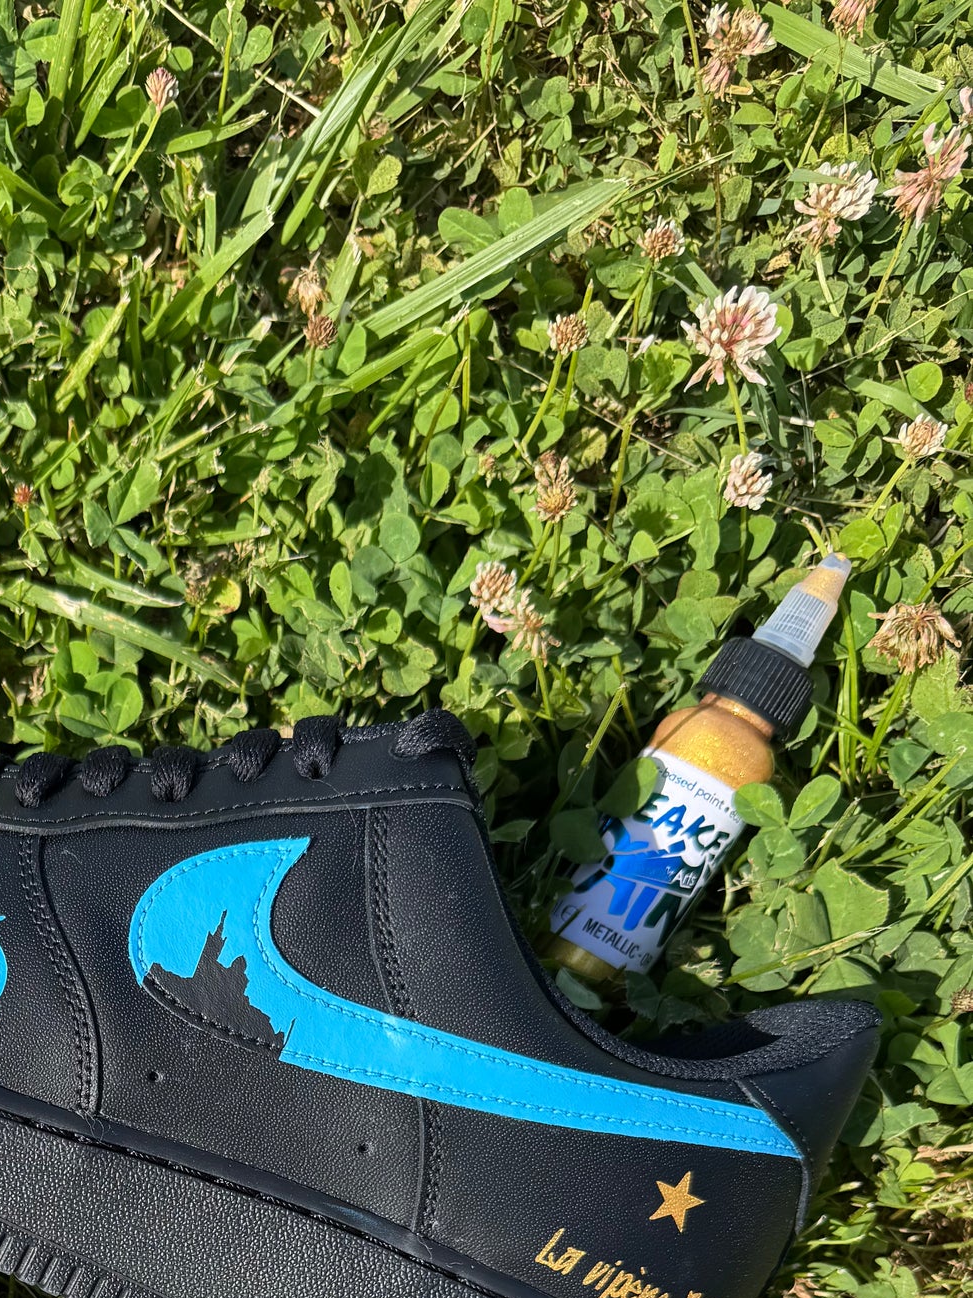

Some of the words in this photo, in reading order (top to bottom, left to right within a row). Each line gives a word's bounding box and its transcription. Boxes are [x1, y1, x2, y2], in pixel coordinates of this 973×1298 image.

[694, 788, 725, 810] paint
[670, 869, 698, 889] Arts
[535, 1227, 586, 1276] La
